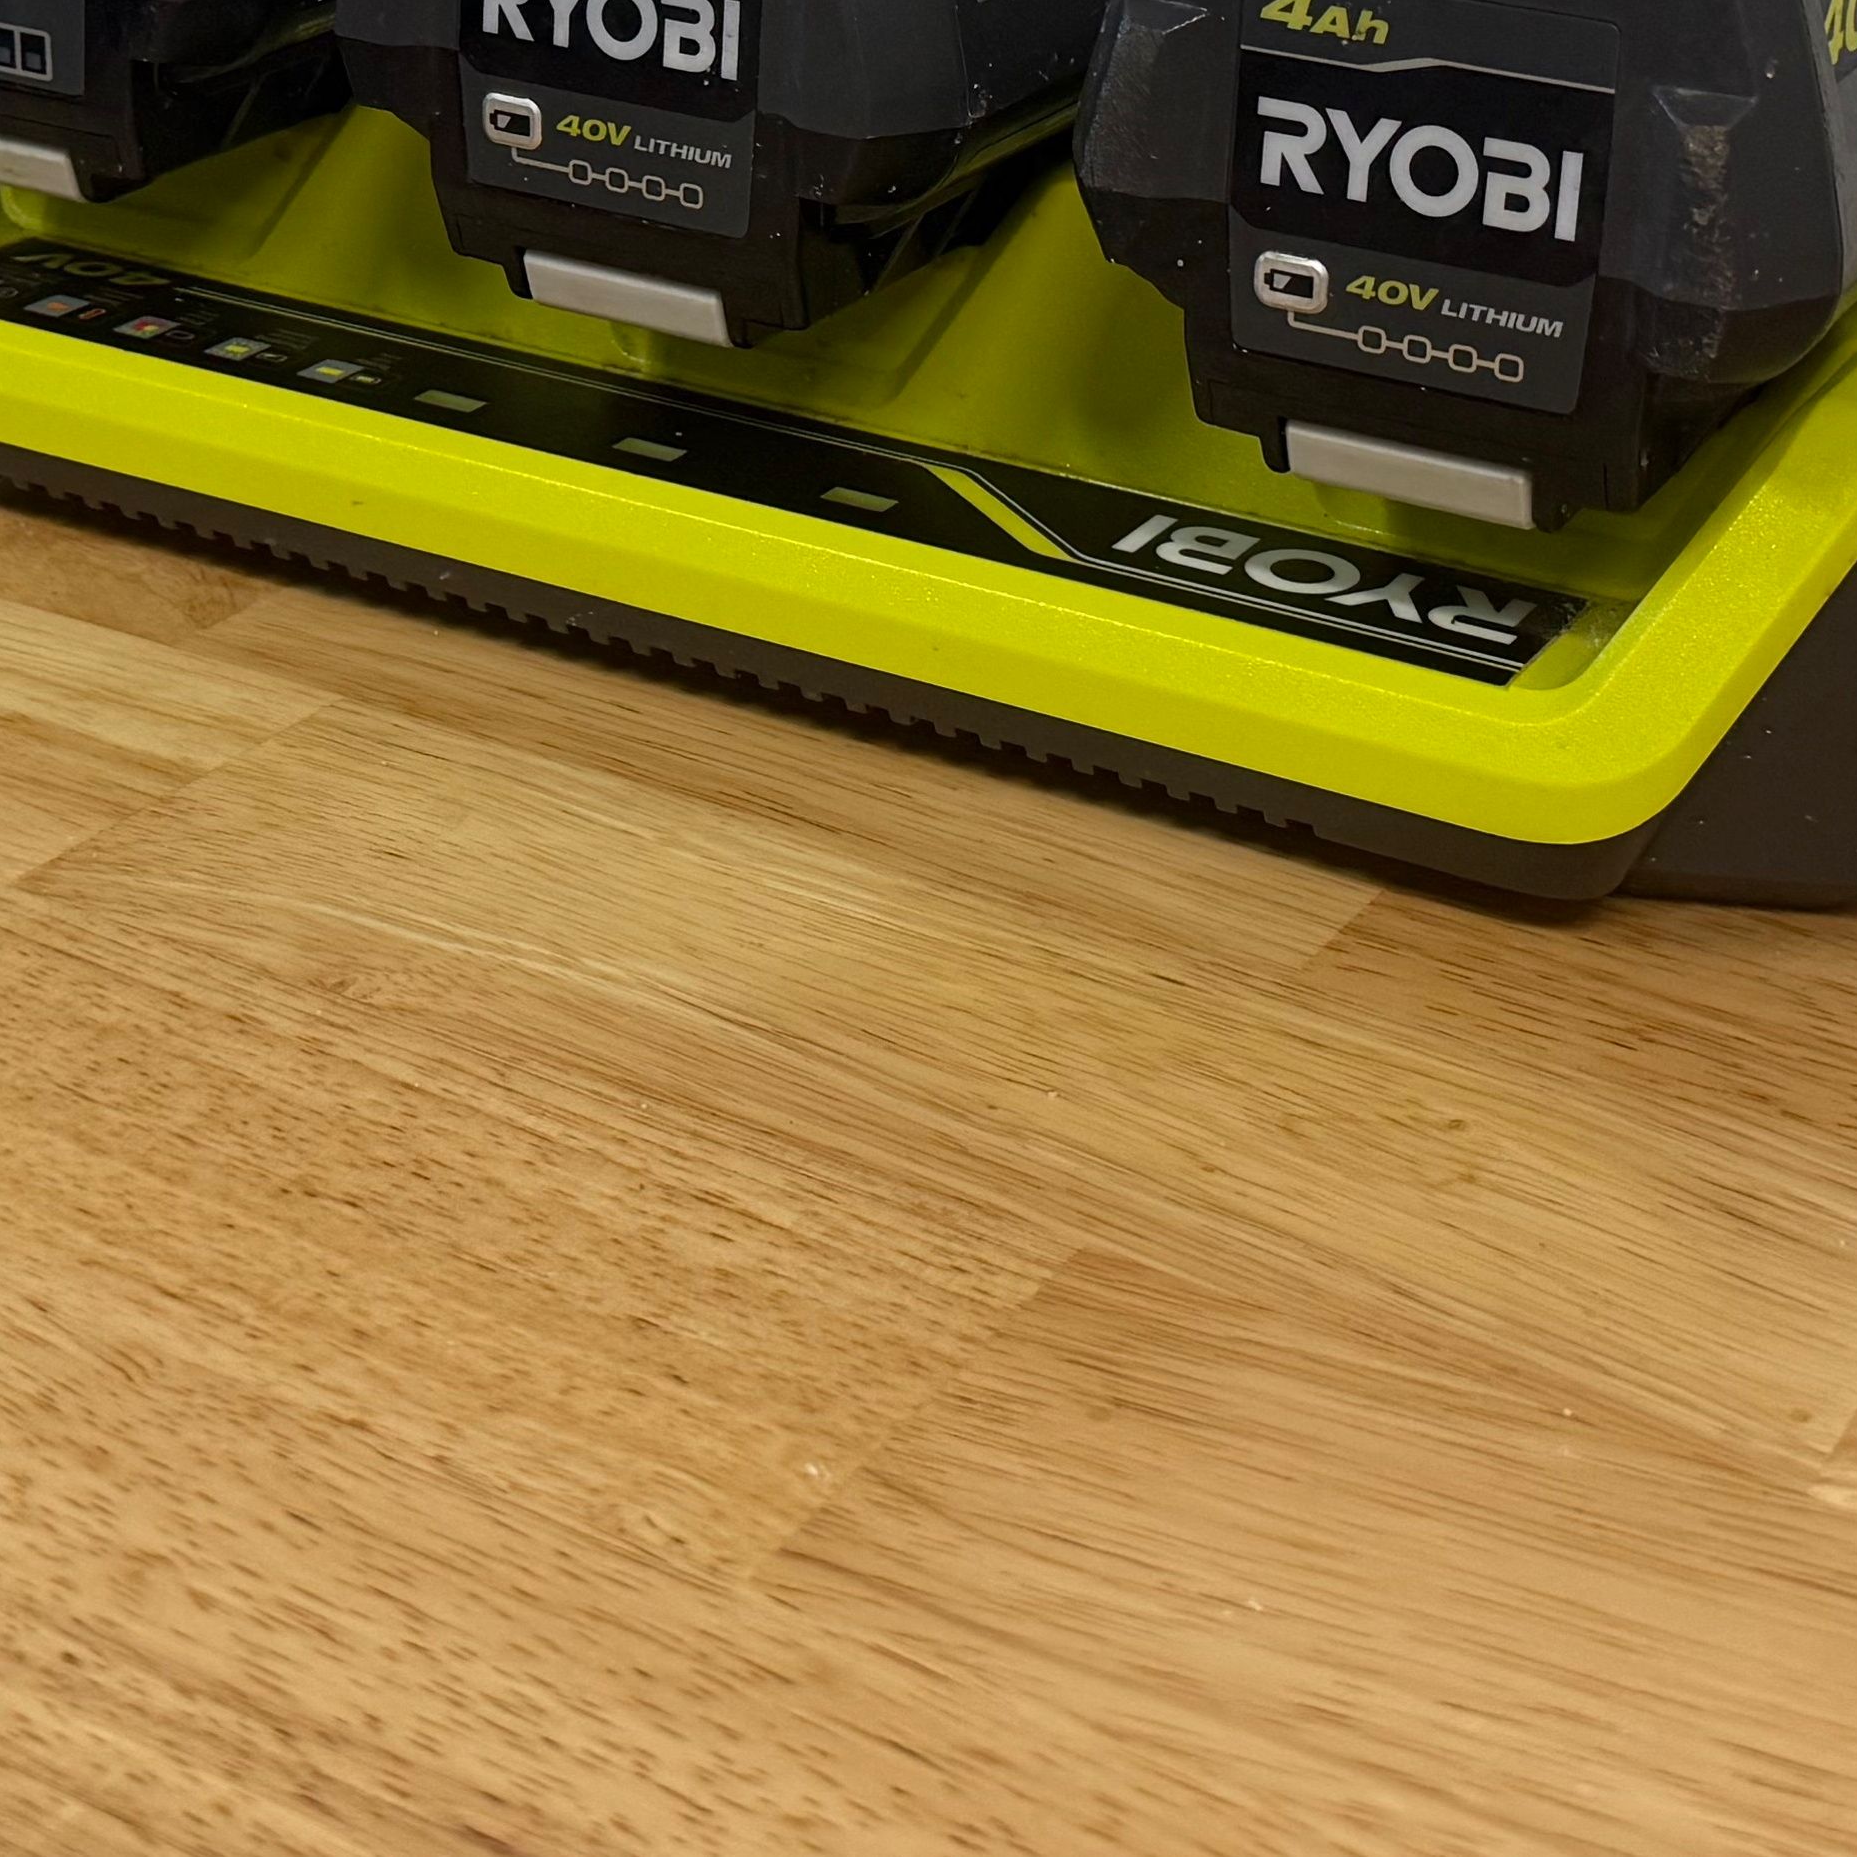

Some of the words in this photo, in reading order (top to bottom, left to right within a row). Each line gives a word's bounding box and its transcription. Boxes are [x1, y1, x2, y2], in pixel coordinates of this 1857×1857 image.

[555, 114, 632, 147] 40V
[633, 134, 733, 170] LITHIUM
[1256, 95, 1584, 242] RYOBI
[1345, 274, 1440, 311] 40V
[1441, 297, 1564, 339] LITHIUM
[1112, 514, 1537, 645] RYOBI
